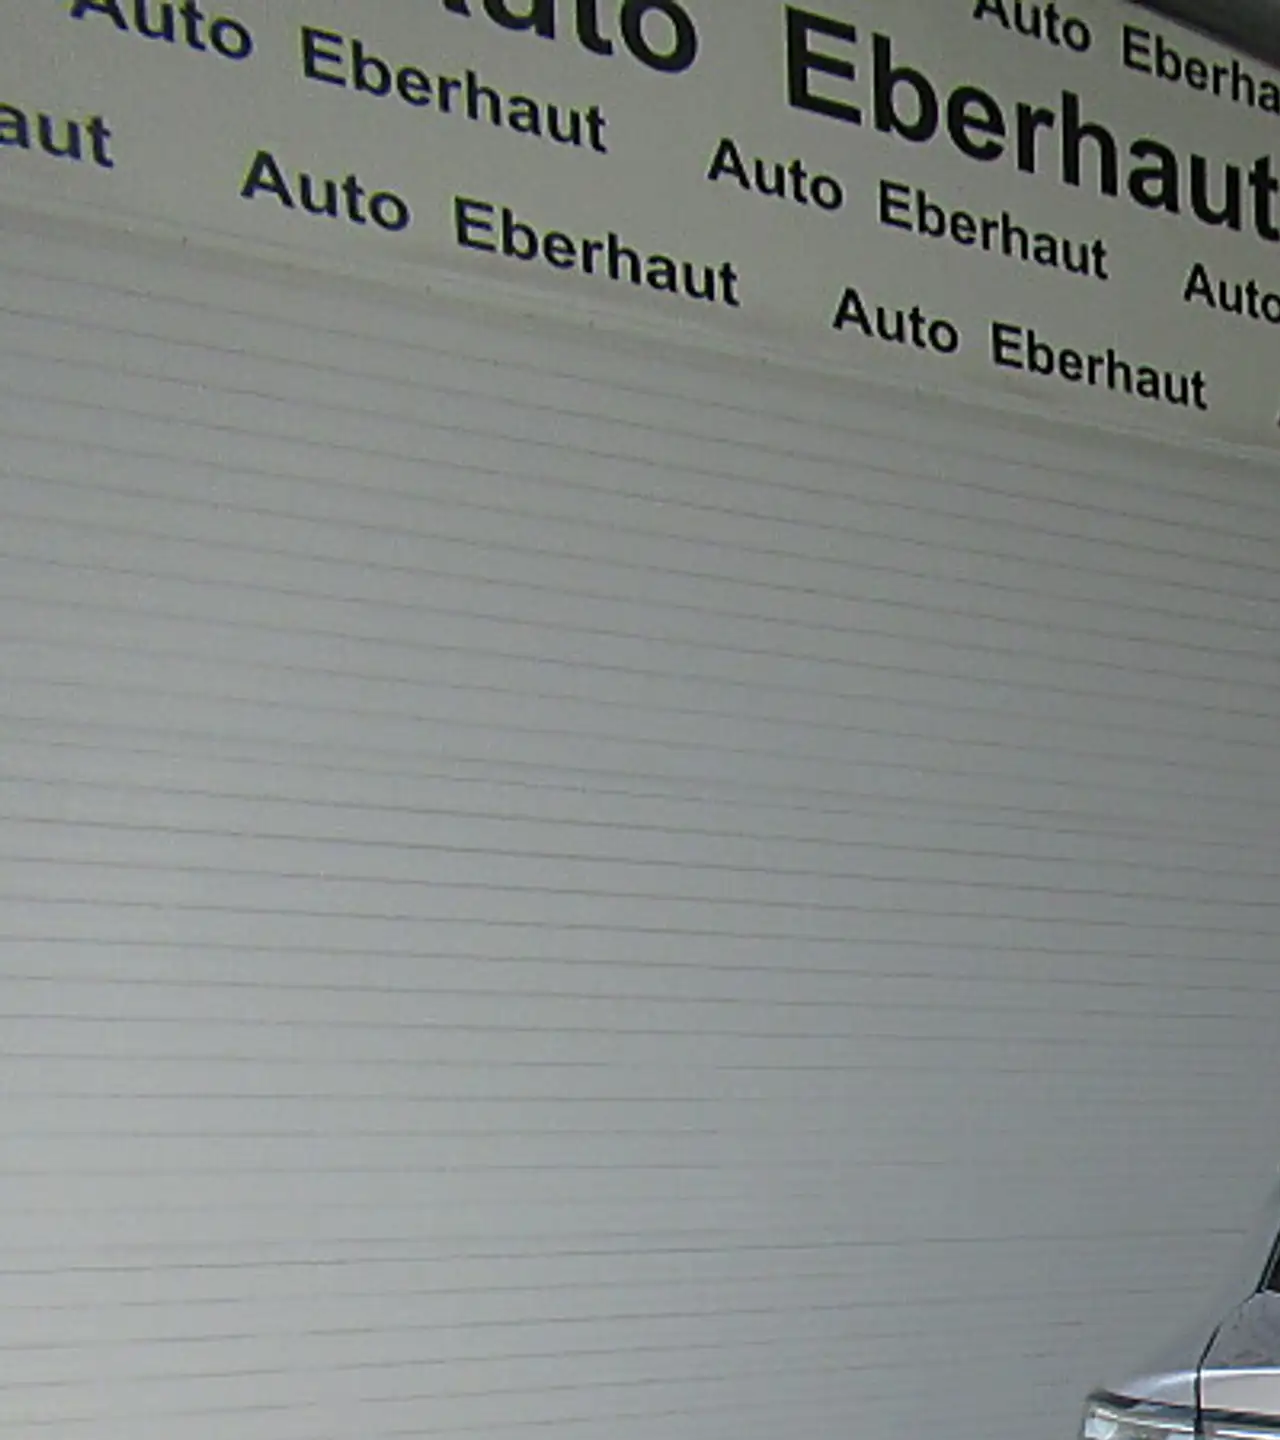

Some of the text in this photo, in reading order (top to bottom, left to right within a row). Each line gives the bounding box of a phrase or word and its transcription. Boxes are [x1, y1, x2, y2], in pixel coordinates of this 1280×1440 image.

[71, 0, 607, 153] Auto Eberhaut
[973, 0, 1090, 52] Auto
[443, 0, 1280, 241] uto Eberhaut
[241, 151, 739, 306] Auto Eberhaut
[708, 138, 1108, 280] Auto Eberhaut
[833, 288, 1207, 410] Auto Eberhaut
